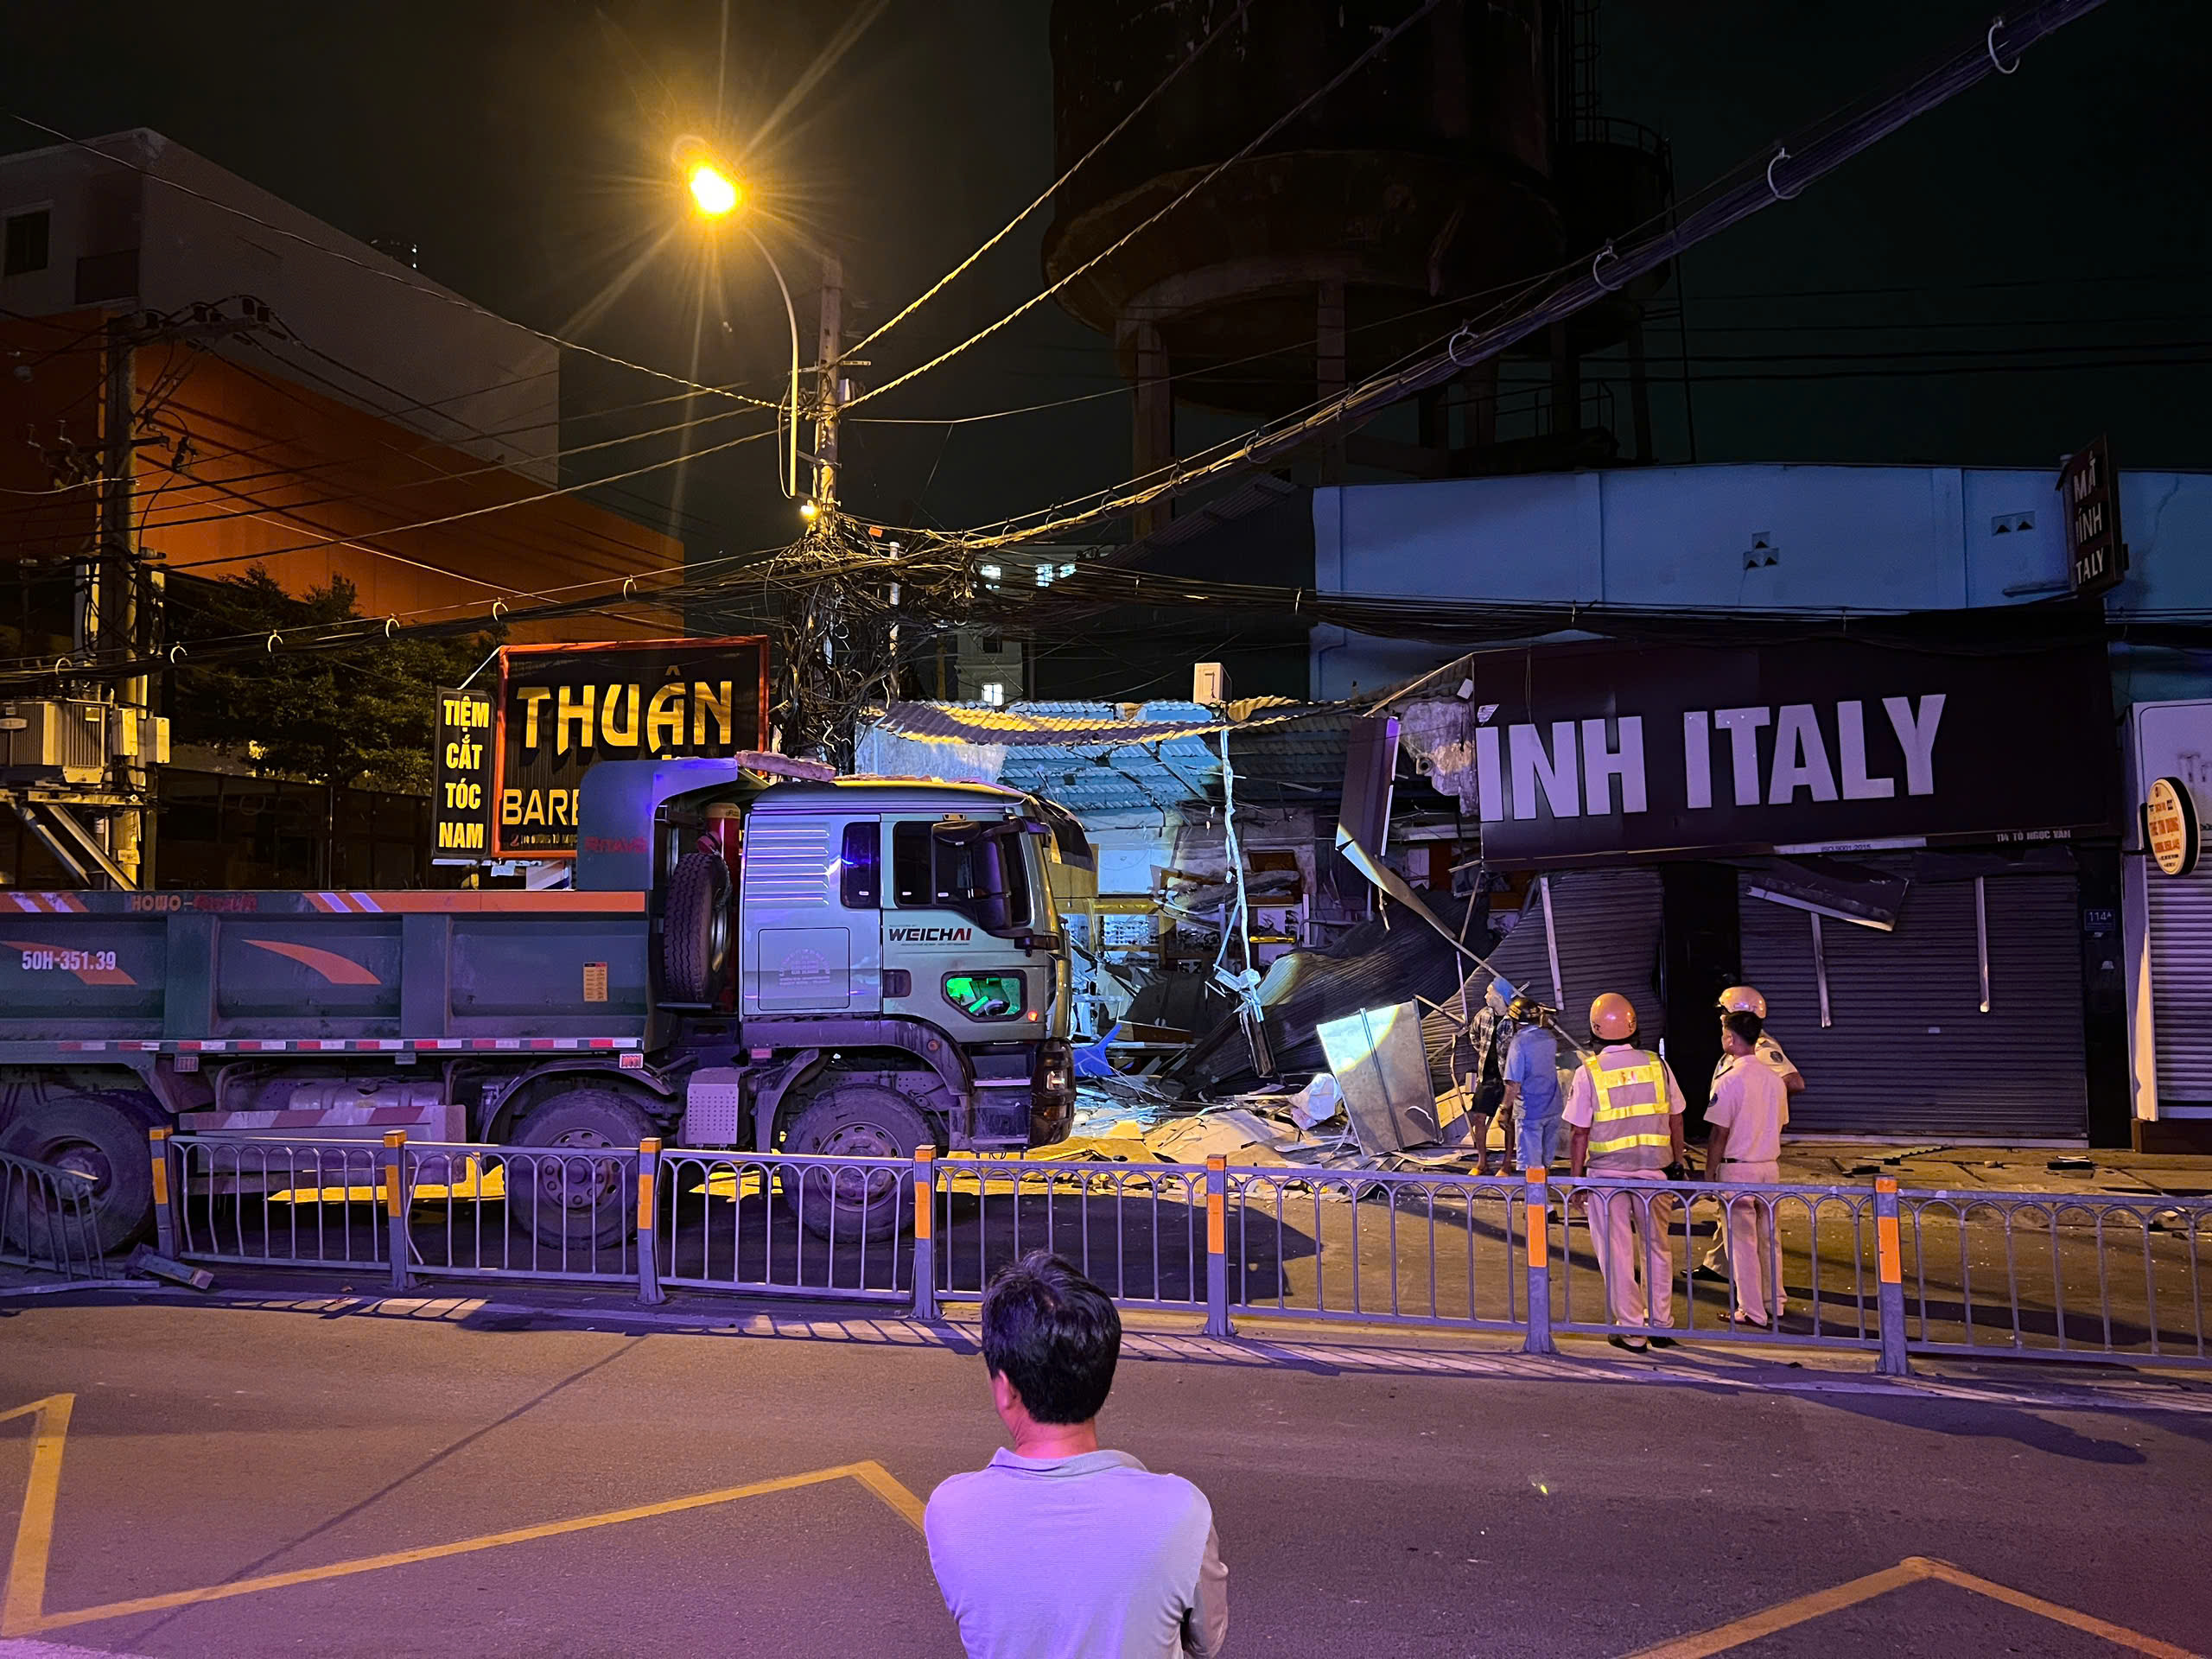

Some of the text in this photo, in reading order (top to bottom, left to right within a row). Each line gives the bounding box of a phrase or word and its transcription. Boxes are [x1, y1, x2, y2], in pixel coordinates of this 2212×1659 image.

[442, 696, 490, 734] TIỆM
[517, 665, 733, 760] THUẬN
[445, 734, 484, 770] CẮT
[1683, 693, 1947, 810] ITALY
[445, 778, 481, 810] TÓC
[438, 822, 484, 849] NAM
[889, 928, 972, 941] WEICHAI
[22, 950, 117, 970] 50H-351.39
